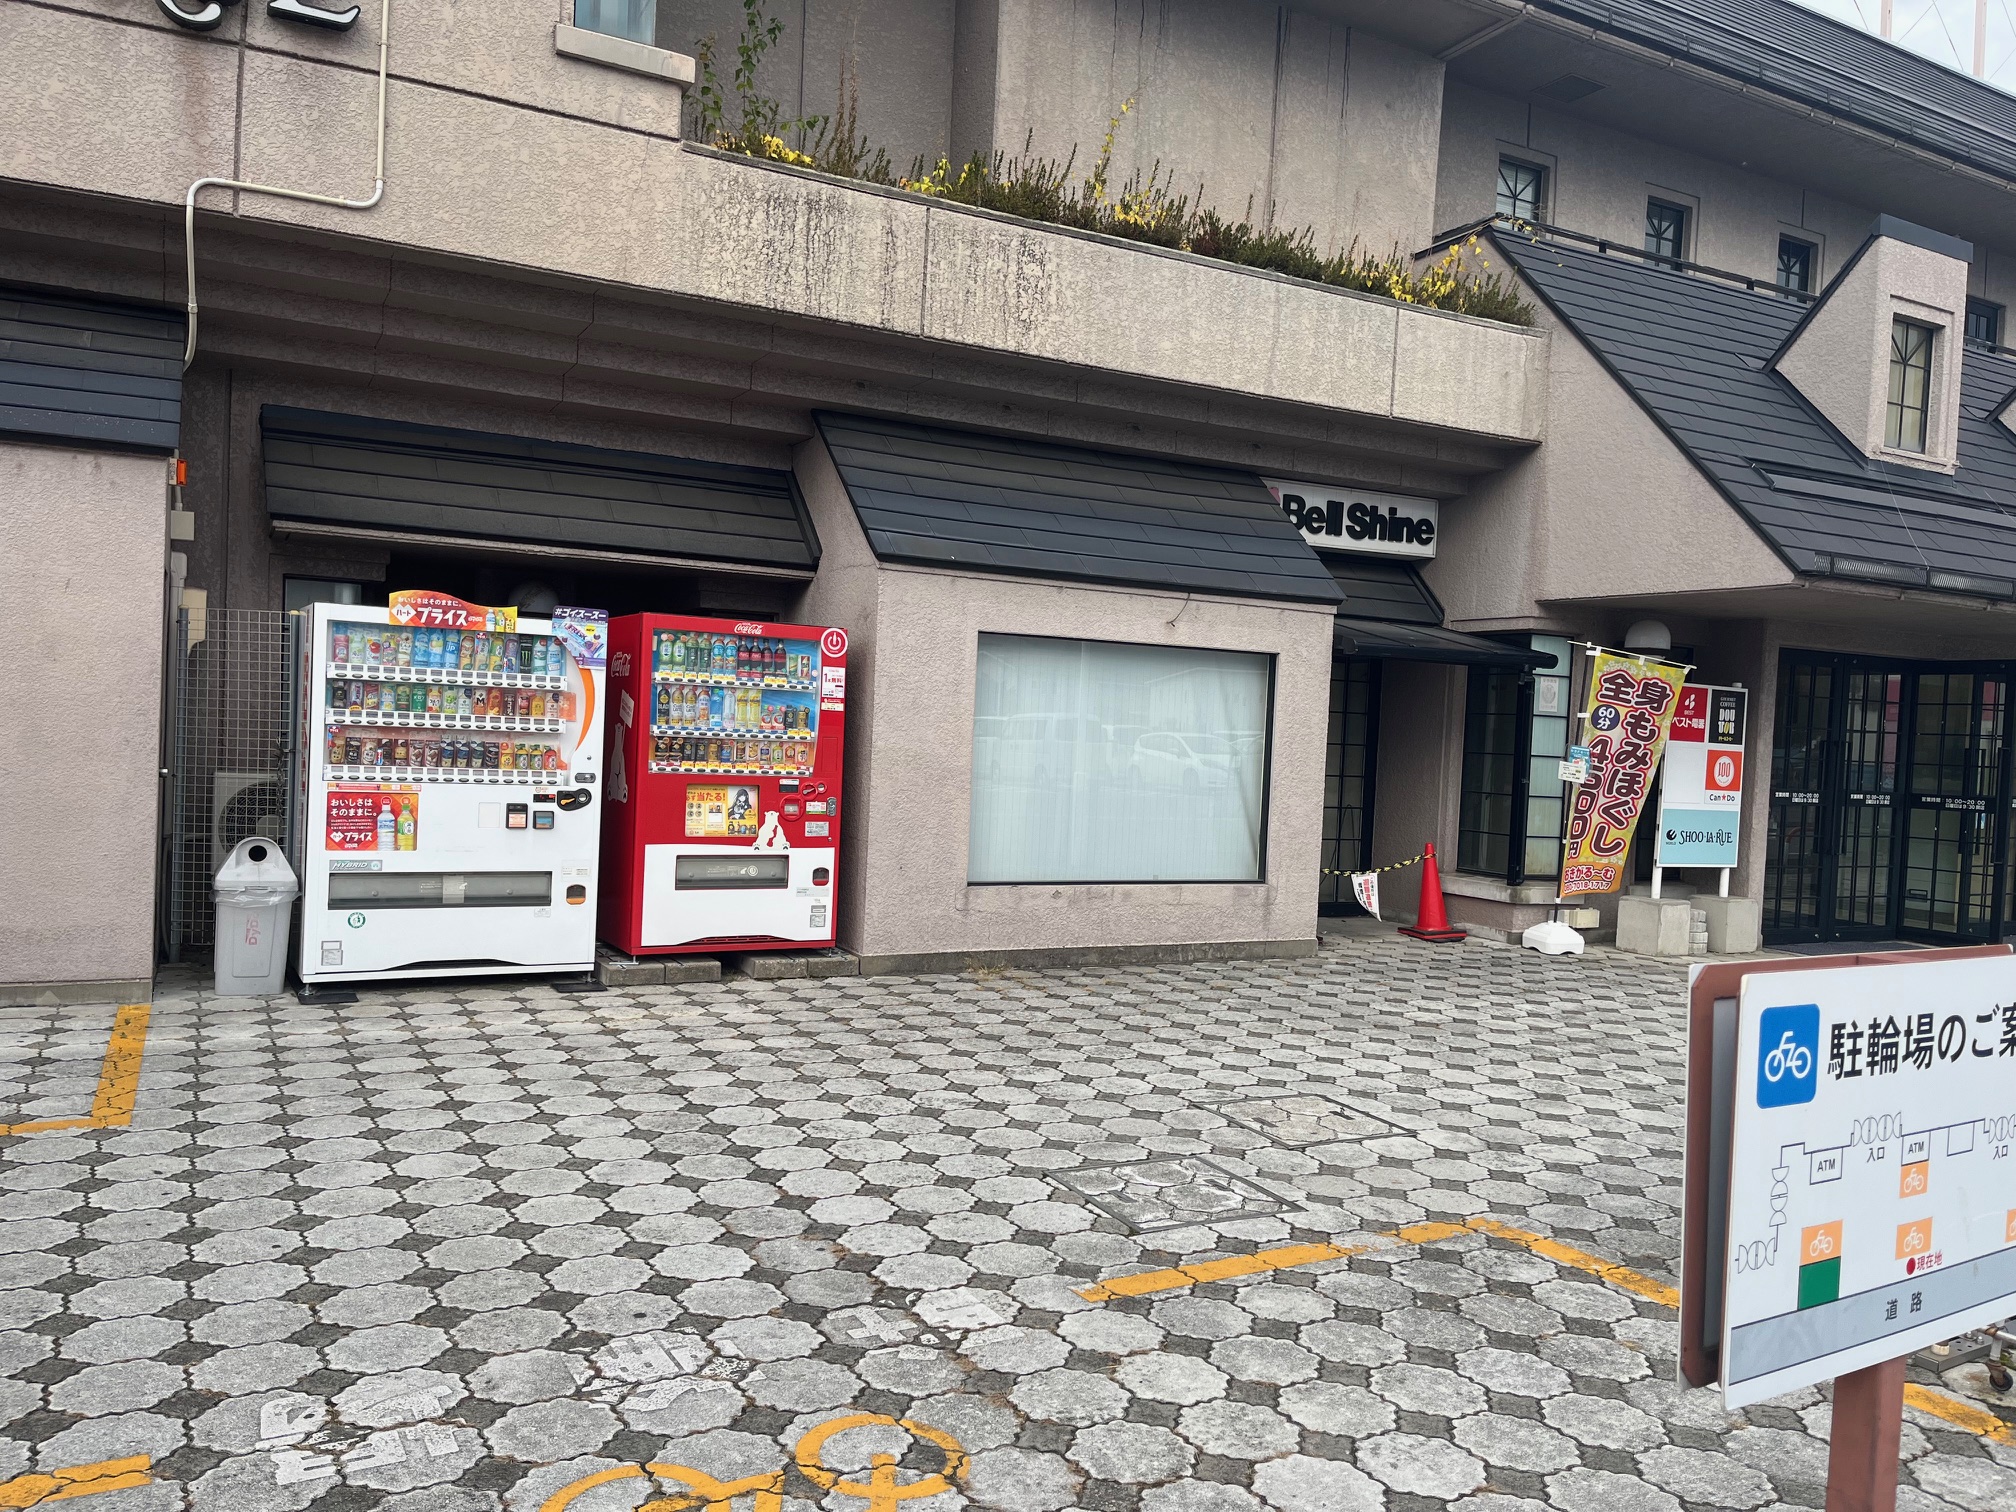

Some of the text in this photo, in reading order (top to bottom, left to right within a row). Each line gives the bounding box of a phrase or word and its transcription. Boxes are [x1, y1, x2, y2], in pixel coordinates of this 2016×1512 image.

[1283, 494, 1434, 546] Bell Shine
[397, 596, 462, 607] おいしさはそのままに。
[417, 607, 468, 626] プライス
[555, 607, 607, 620] #ゴイスースー
[1599, 669, 1674, 714] 全身
[1672, 716, 1706, 729] ベスト電器
[1717, 762, 1731, 778] 100
[1590, 710, 1660, 858] もみほぐし
[330, 798, 373, 807] おいしさは
[330, 808, 377, 817] そのままに。
[344, 831, 373, 842] プライス
[332, 861, 368, 870] HYBRID
[1866, 1146, 1886, 1163] 入口
[1907, 1141, 1925, 1155] ATM
[1992, 1144, 2009, 1161] 入口
[1817, 1158, 1836, 1173] ATM
[1916, 1249, 1943, 1272] 現在地
